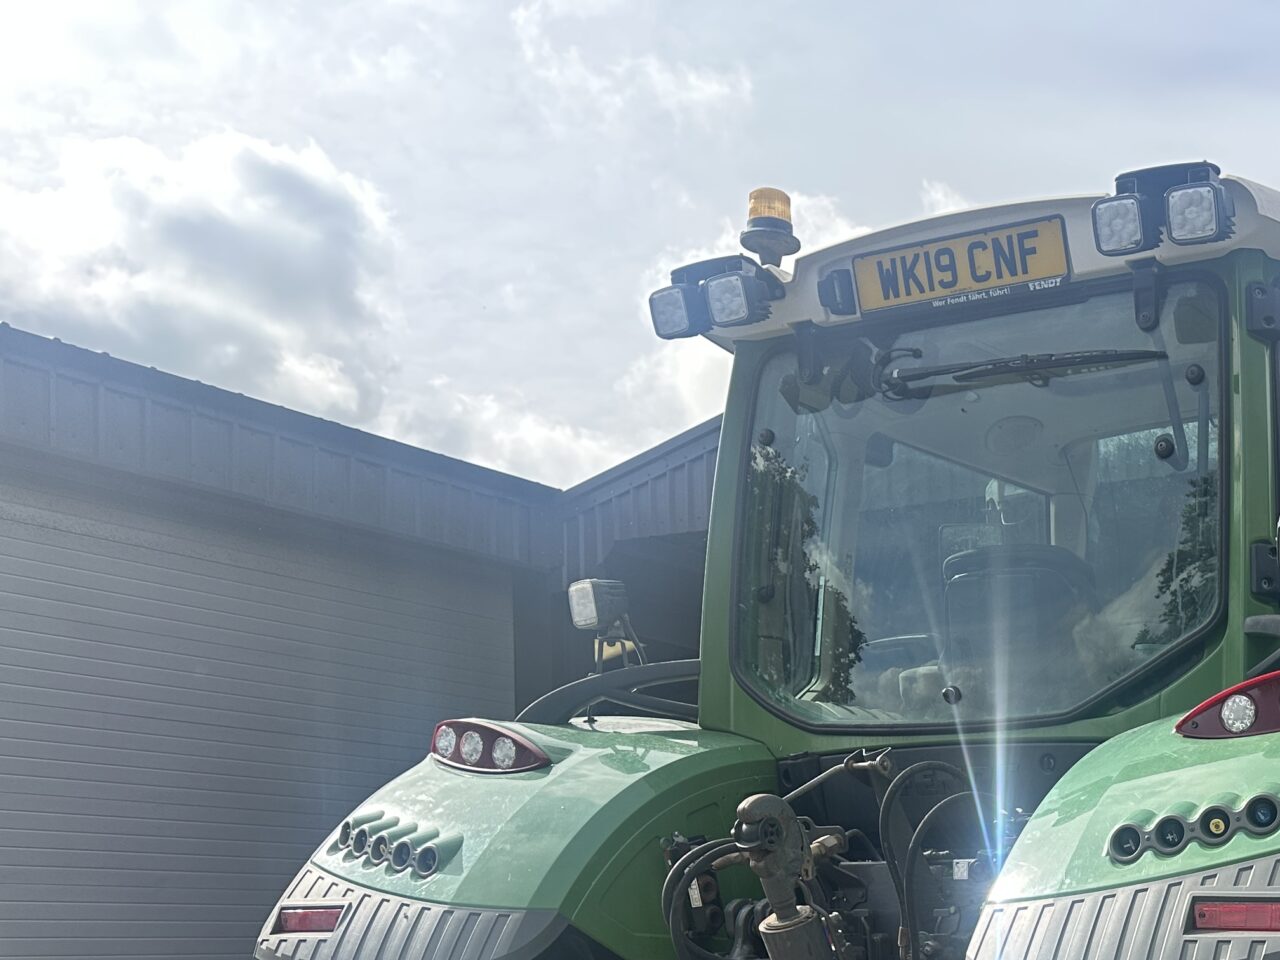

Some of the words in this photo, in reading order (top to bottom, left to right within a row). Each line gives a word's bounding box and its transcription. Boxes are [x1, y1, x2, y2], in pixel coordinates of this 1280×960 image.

[877, 247, 959, 300] WK19
[967, 229, 1039, 283] CNF
[1027, 277, 1062, 292] FENDT
